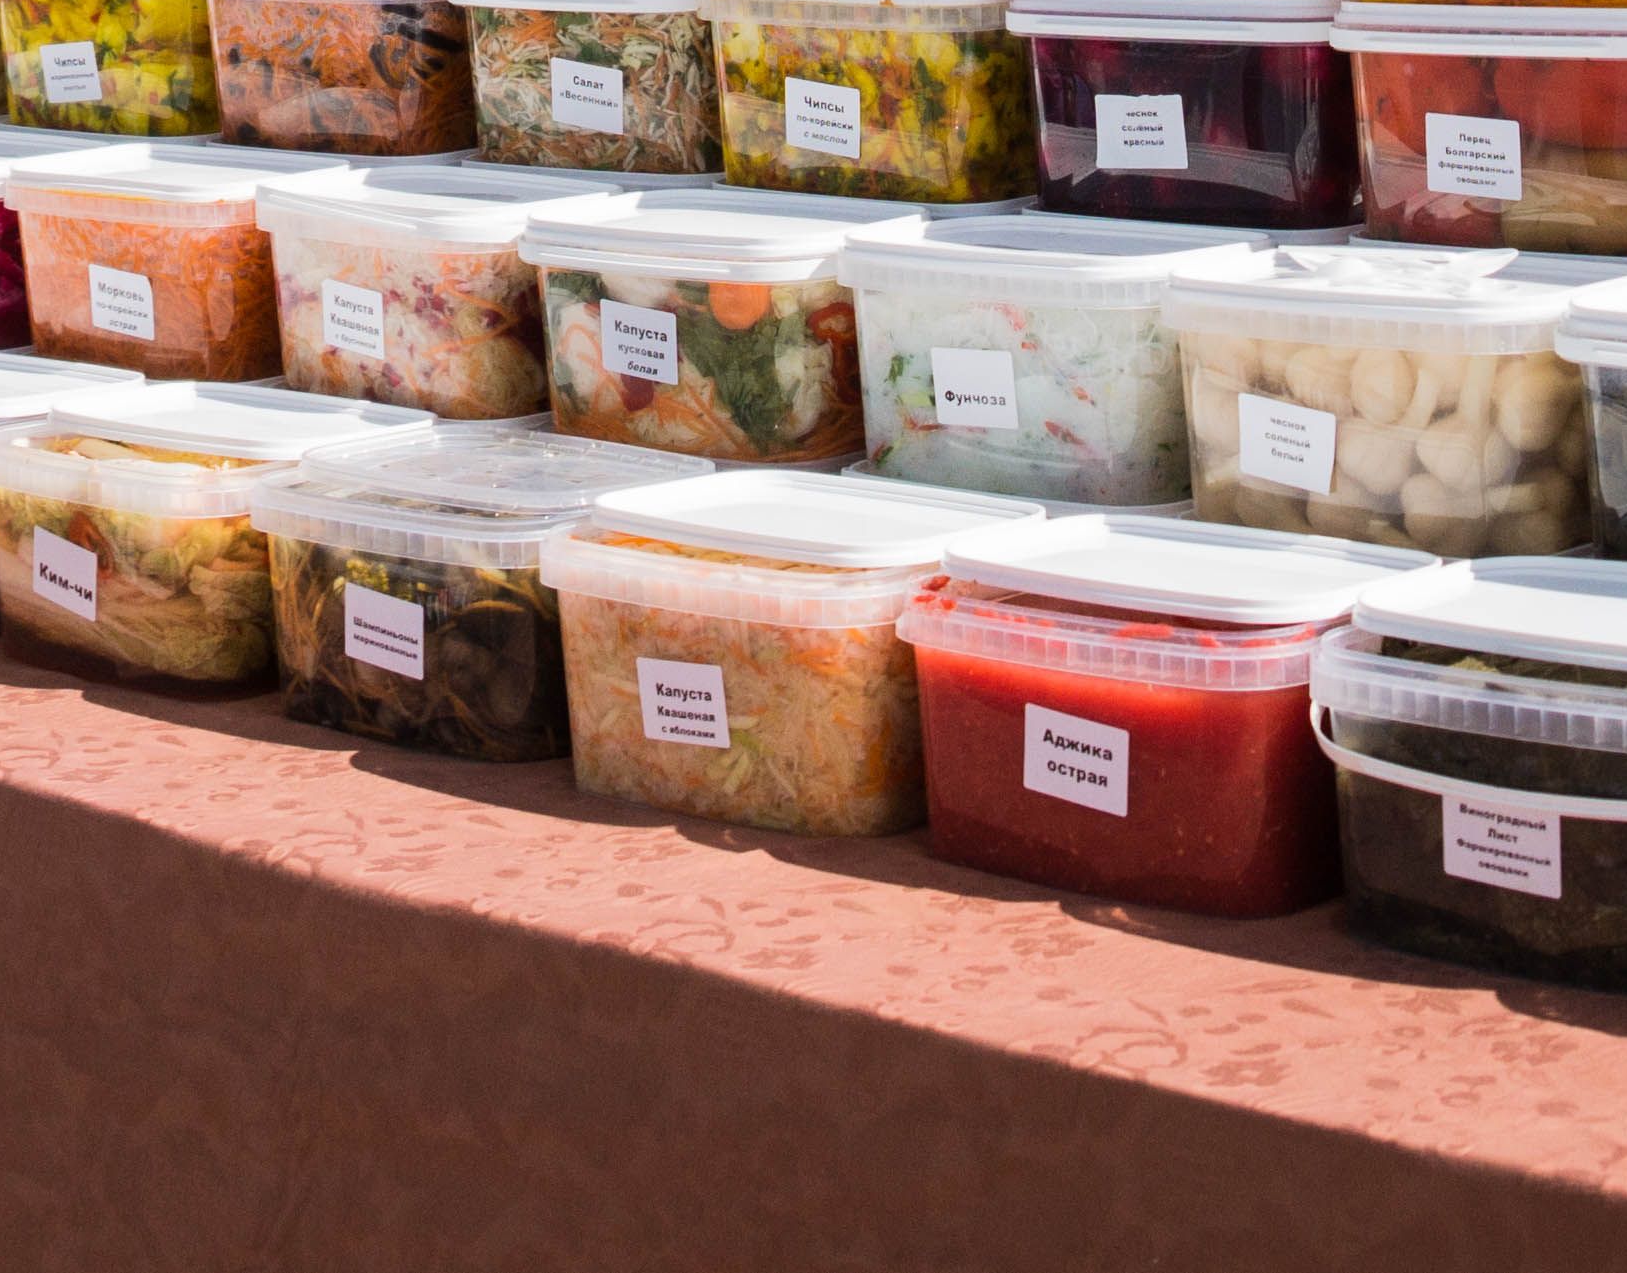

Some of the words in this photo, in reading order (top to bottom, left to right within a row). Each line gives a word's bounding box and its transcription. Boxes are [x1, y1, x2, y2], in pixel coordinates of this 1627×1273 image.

[54, 56, 86, 66] Чипсы
[573, 75, 604, 90] Салат
[560, 90, 618, 108] «Весенний»
[804, 95, 844, 113] Чипсы
[796, 114, 854, 131] по-корейски
[812, 132, 848, 145] маслом
[1123, 138, 1164, 148] красный
[1459, 133, 1491, 146] Перец
[1445, 146, 1506, 161] Болгарский
[98, 281, 144, 303] Морковь
[95, 300, 148, 319] по-корейски
[334, 294, 374, 316] Капуста
[109, 319, 138, 331] острая
[329, 312, 380, 336] Квашеная
[614, 319, 667, 342] Капуста
[617, 342, 665, 360] кусковая
[627, 360, 658, 376] белая
[945, 390, 1006, 406] Фунчоза
[1270, 417, 1307, 432] чеснок
[1265, 431, 1311, 449] соленый
[39, 562, 93, 602] Ким-чи
[353, 616, 419, 645] Шампиньоны
[655, 682, 712, 702] Капуста
[657, 705, 716, 723] Квашеная
[661, 725, 667, 733] с
[670, 725, 716, 739] яблоками
[1043, 729, 1113, 762] Аджика
[1047, 759, 1108, 788] острая
[1459, 802, 1547, 832] Виноградный
